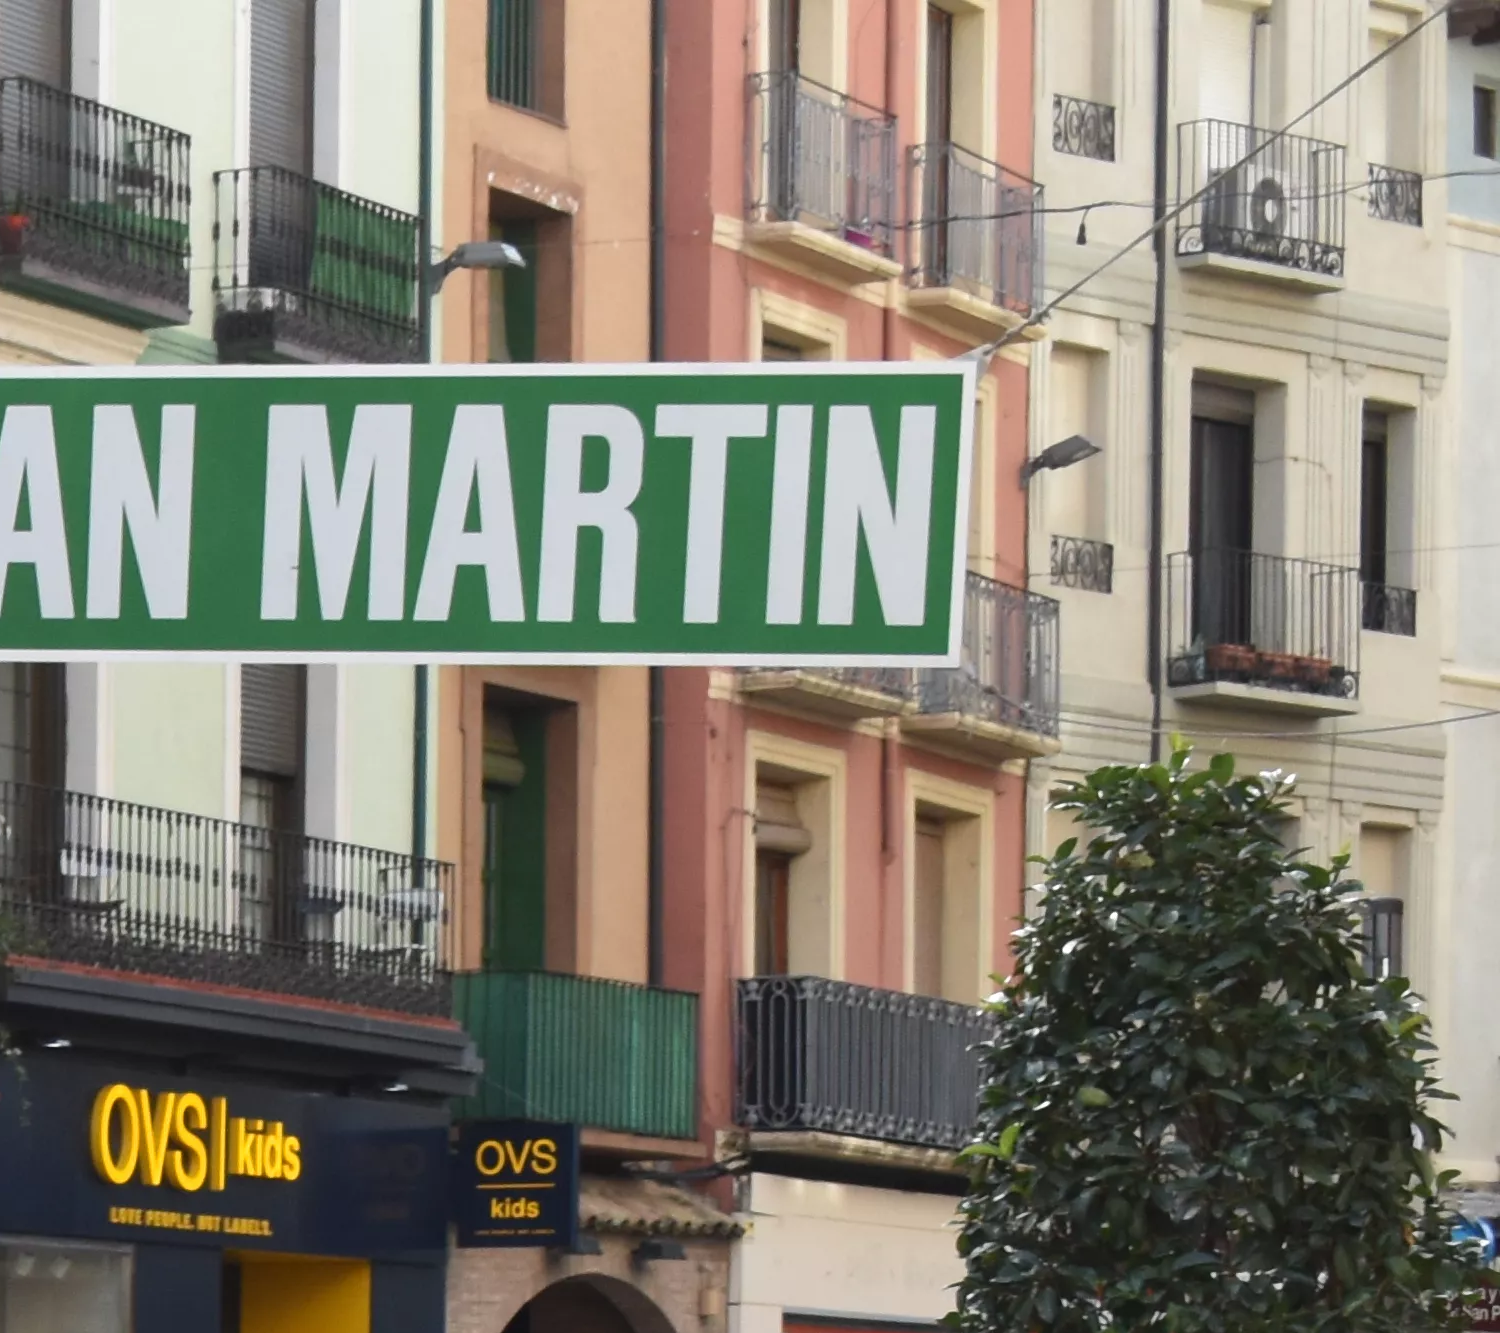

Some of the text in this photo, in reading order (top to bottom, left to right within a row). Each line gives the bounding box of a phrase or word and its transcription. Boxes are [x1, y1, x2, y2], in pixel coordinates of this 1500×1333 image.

[259, 403, 937, 627] MARTIN
[90, 1083, 301, 1192] OVS kids
[475, 1138, 557, 1175] OVS
[490, 1197, 541, 1218] kids
